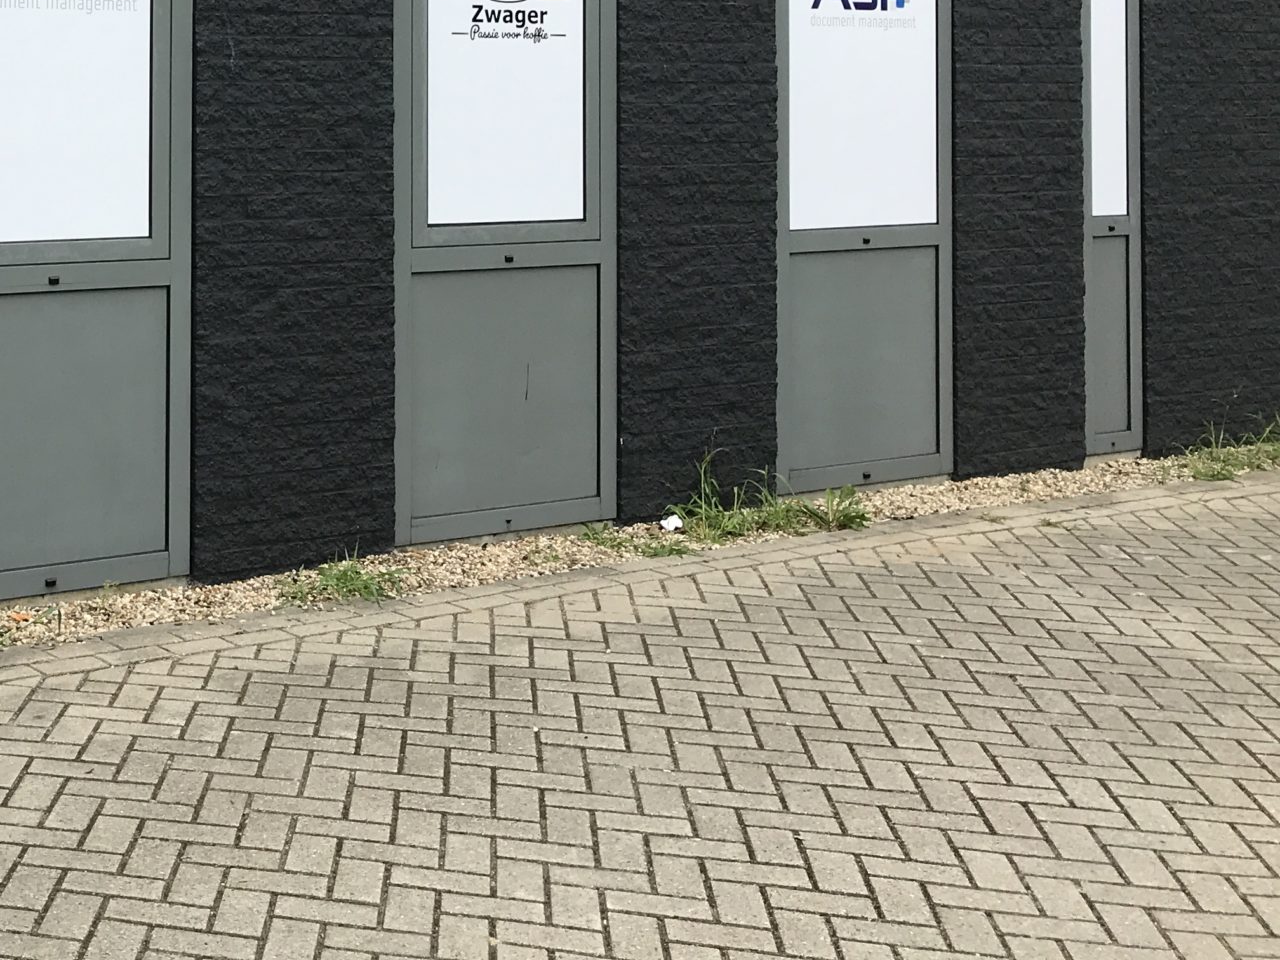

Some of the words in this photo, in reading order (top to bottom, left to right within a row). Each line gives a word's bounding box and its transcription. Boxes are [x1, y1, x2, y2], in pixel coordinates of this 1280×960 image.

[471, 4, 548, 28] Zwager
[810, 14, 856, 28] document
[858, 16, 917, 31] management
[469, 24, 500, 41] Passie
[501, 30, 522, 39] voor
[523, 27, 549, 43] koffie
